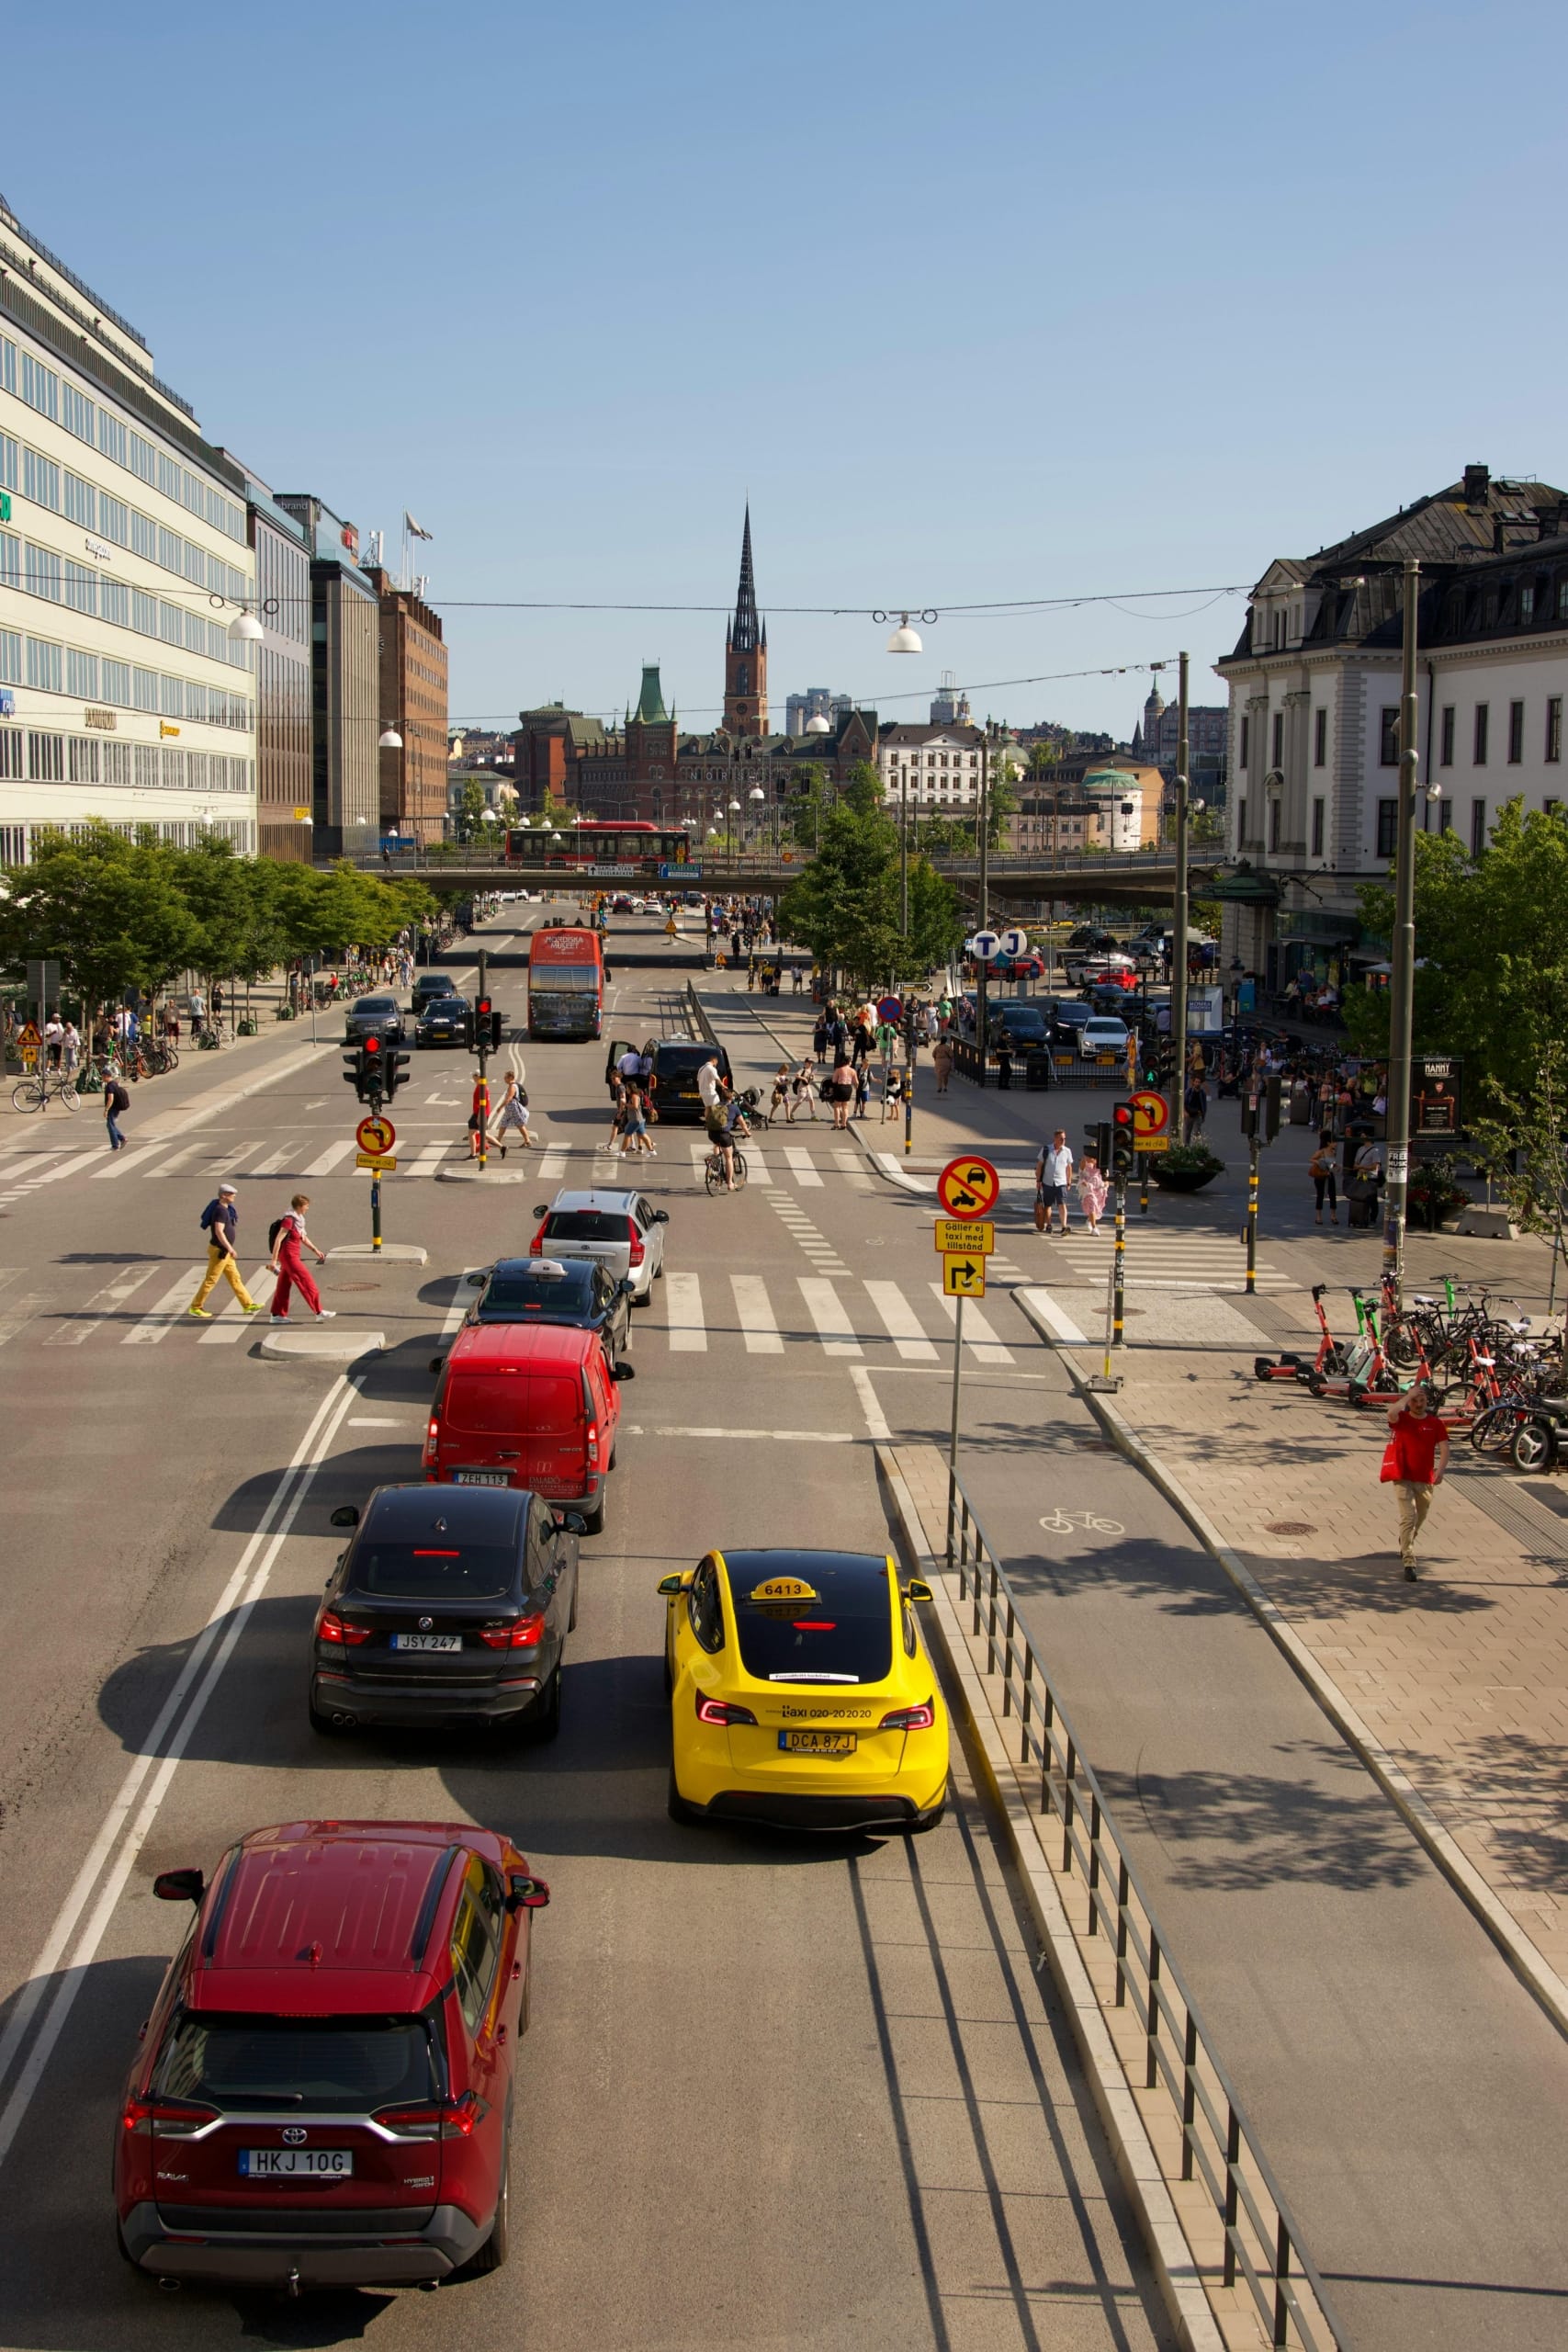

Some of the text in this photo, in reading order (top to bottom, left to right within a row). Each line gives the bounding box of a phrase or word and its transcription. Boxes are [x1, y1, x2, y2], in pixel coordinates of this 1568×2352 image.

[976, 933, 1019, 956] T J
[945, 1223, 984, 1233] Gäller ej
[947, 1242, 983, 1250] tillstånd
[462, 1475, 504, 1485] ZEH 113
[765, 1585, 801, 1595] 6413
[402, 1636, 457, 1649] JSY 247
[792, 1735, 850, 1748] DCA 87J
[257, 2153, 344, 2171] HKJ 10G
